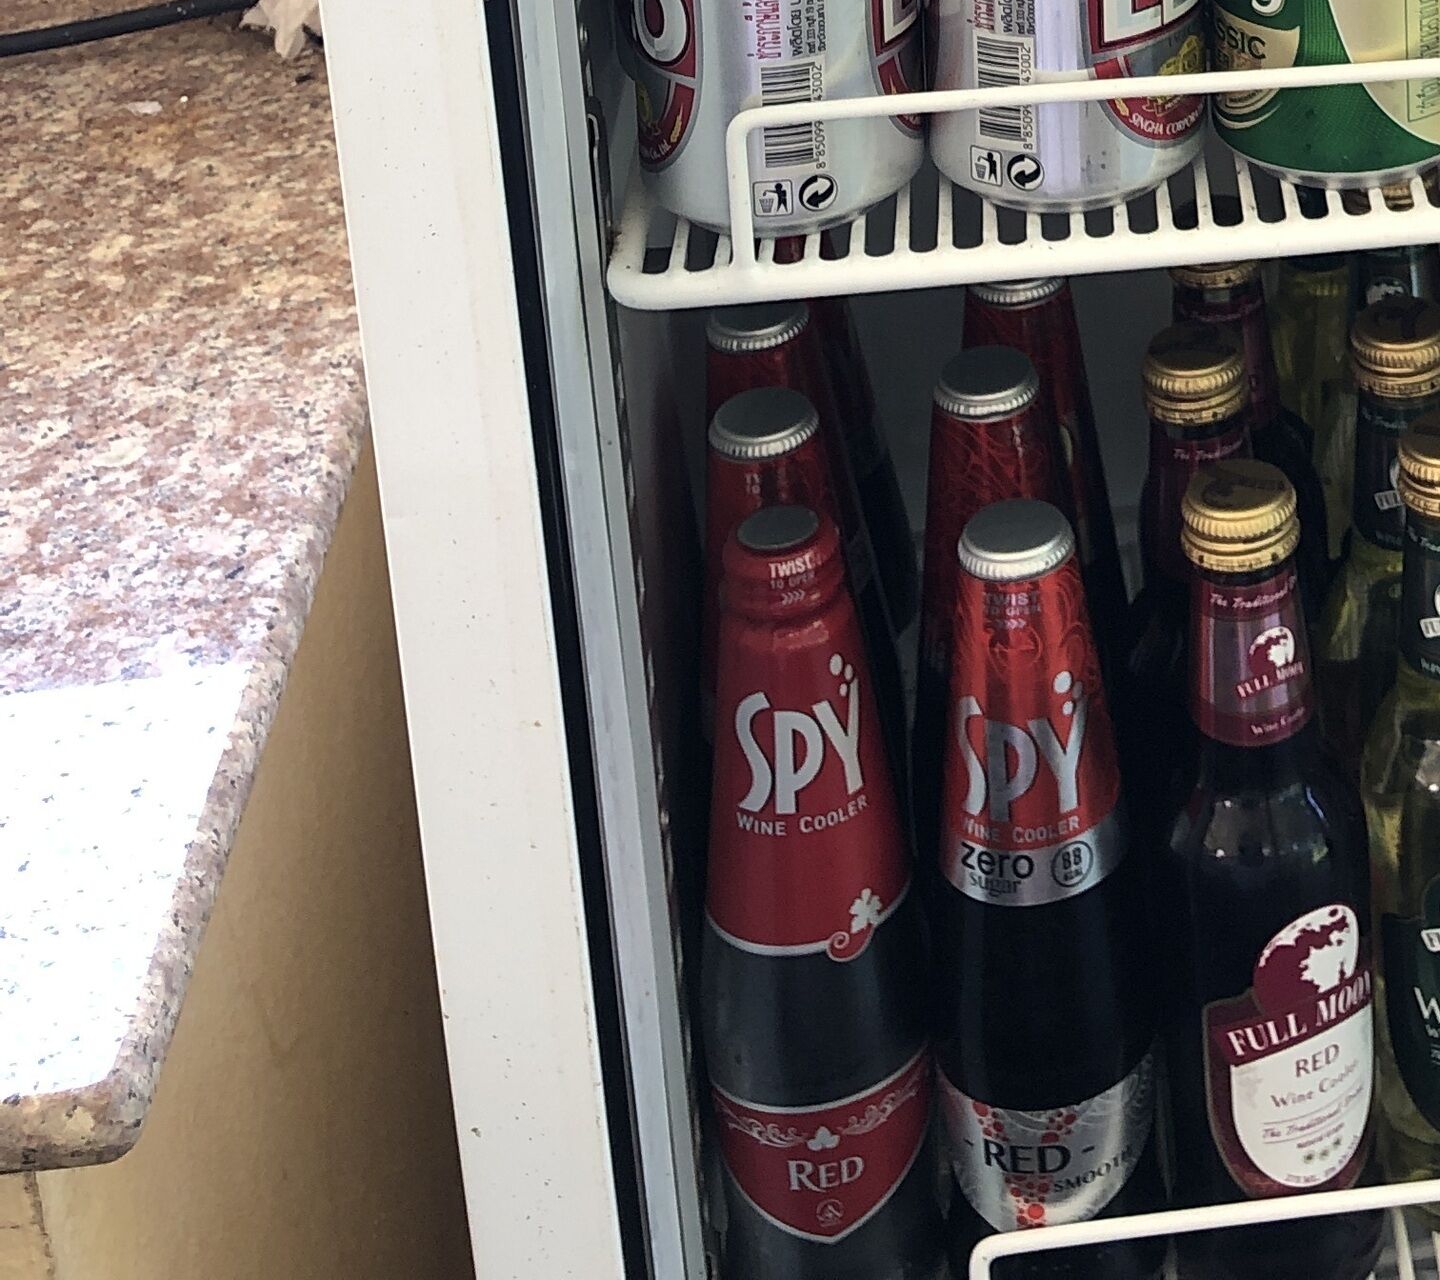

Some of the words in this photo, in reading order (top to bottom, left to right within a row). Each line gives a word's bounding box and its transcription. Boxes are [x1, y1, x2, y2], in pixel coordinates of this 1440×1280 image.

[769, 555, 813, 579] TWIST
[985, 593, 1037, 606] TWIST
[734, 676, 867, 816] SPY
[958, 696, 1088, 822] SPY
[735, 812, 786, 837] WINE
[799, 795, 868, 833] COOLER
[1011, 815, 1080, 843] COOLER
[960, 842, 1034, 880] zero
[970, 874, 1022, 898] sugar
[1227, 1013, 1307, 1056] FULL
[1296, 1043, 1340, 1078] RED
[1270, 1091, 1313, 1108] Wine
[786, 1156, 864, 1193] RED
[983, 1139, 1072, 1175] RED
